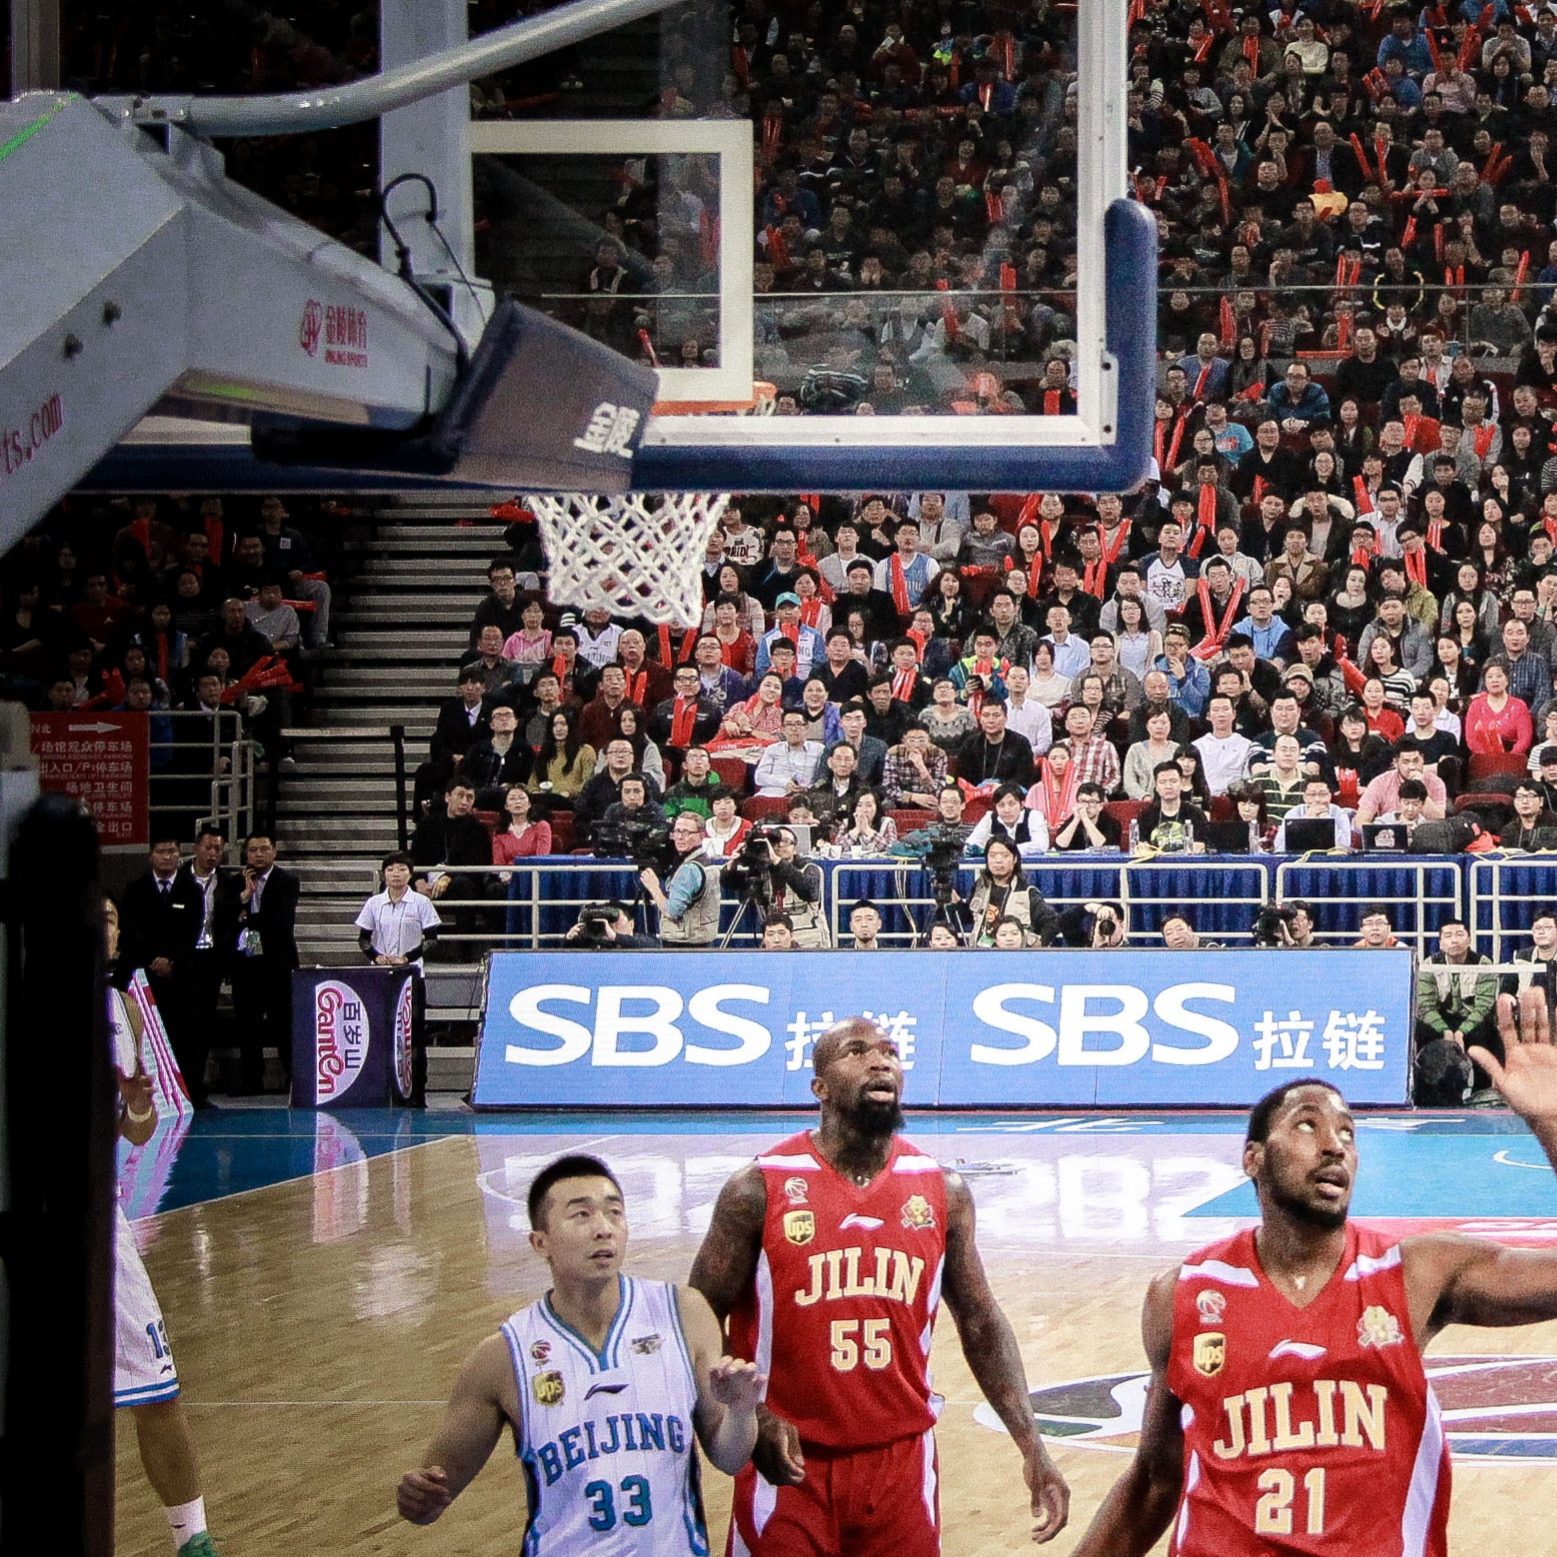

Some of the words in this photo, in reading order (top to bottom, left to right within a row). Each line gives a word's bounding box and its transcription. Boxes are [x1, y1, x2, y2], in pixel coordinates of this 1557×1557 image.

[0, 393, 63, 474] ts.com
[343, 1001, 361, 1069] 百岁山
[505, 983, 773, 1067] SBS
[970, 982, 1240, 1067] SBS
[1252, 1009, 1386, 1072] 拉链
[788, 1219, 813, 1241] ups
[794, 1246, 925, 1306] JILIN
[830, 1317, 892, 1371] 55
[537, 1412, 685, 1487] BEIJING
[1213, 1379, 1388, 1460] JILIN
[584, 1474, 653, 1532] 33
[1254, 1467, 1326, 1536] 21
